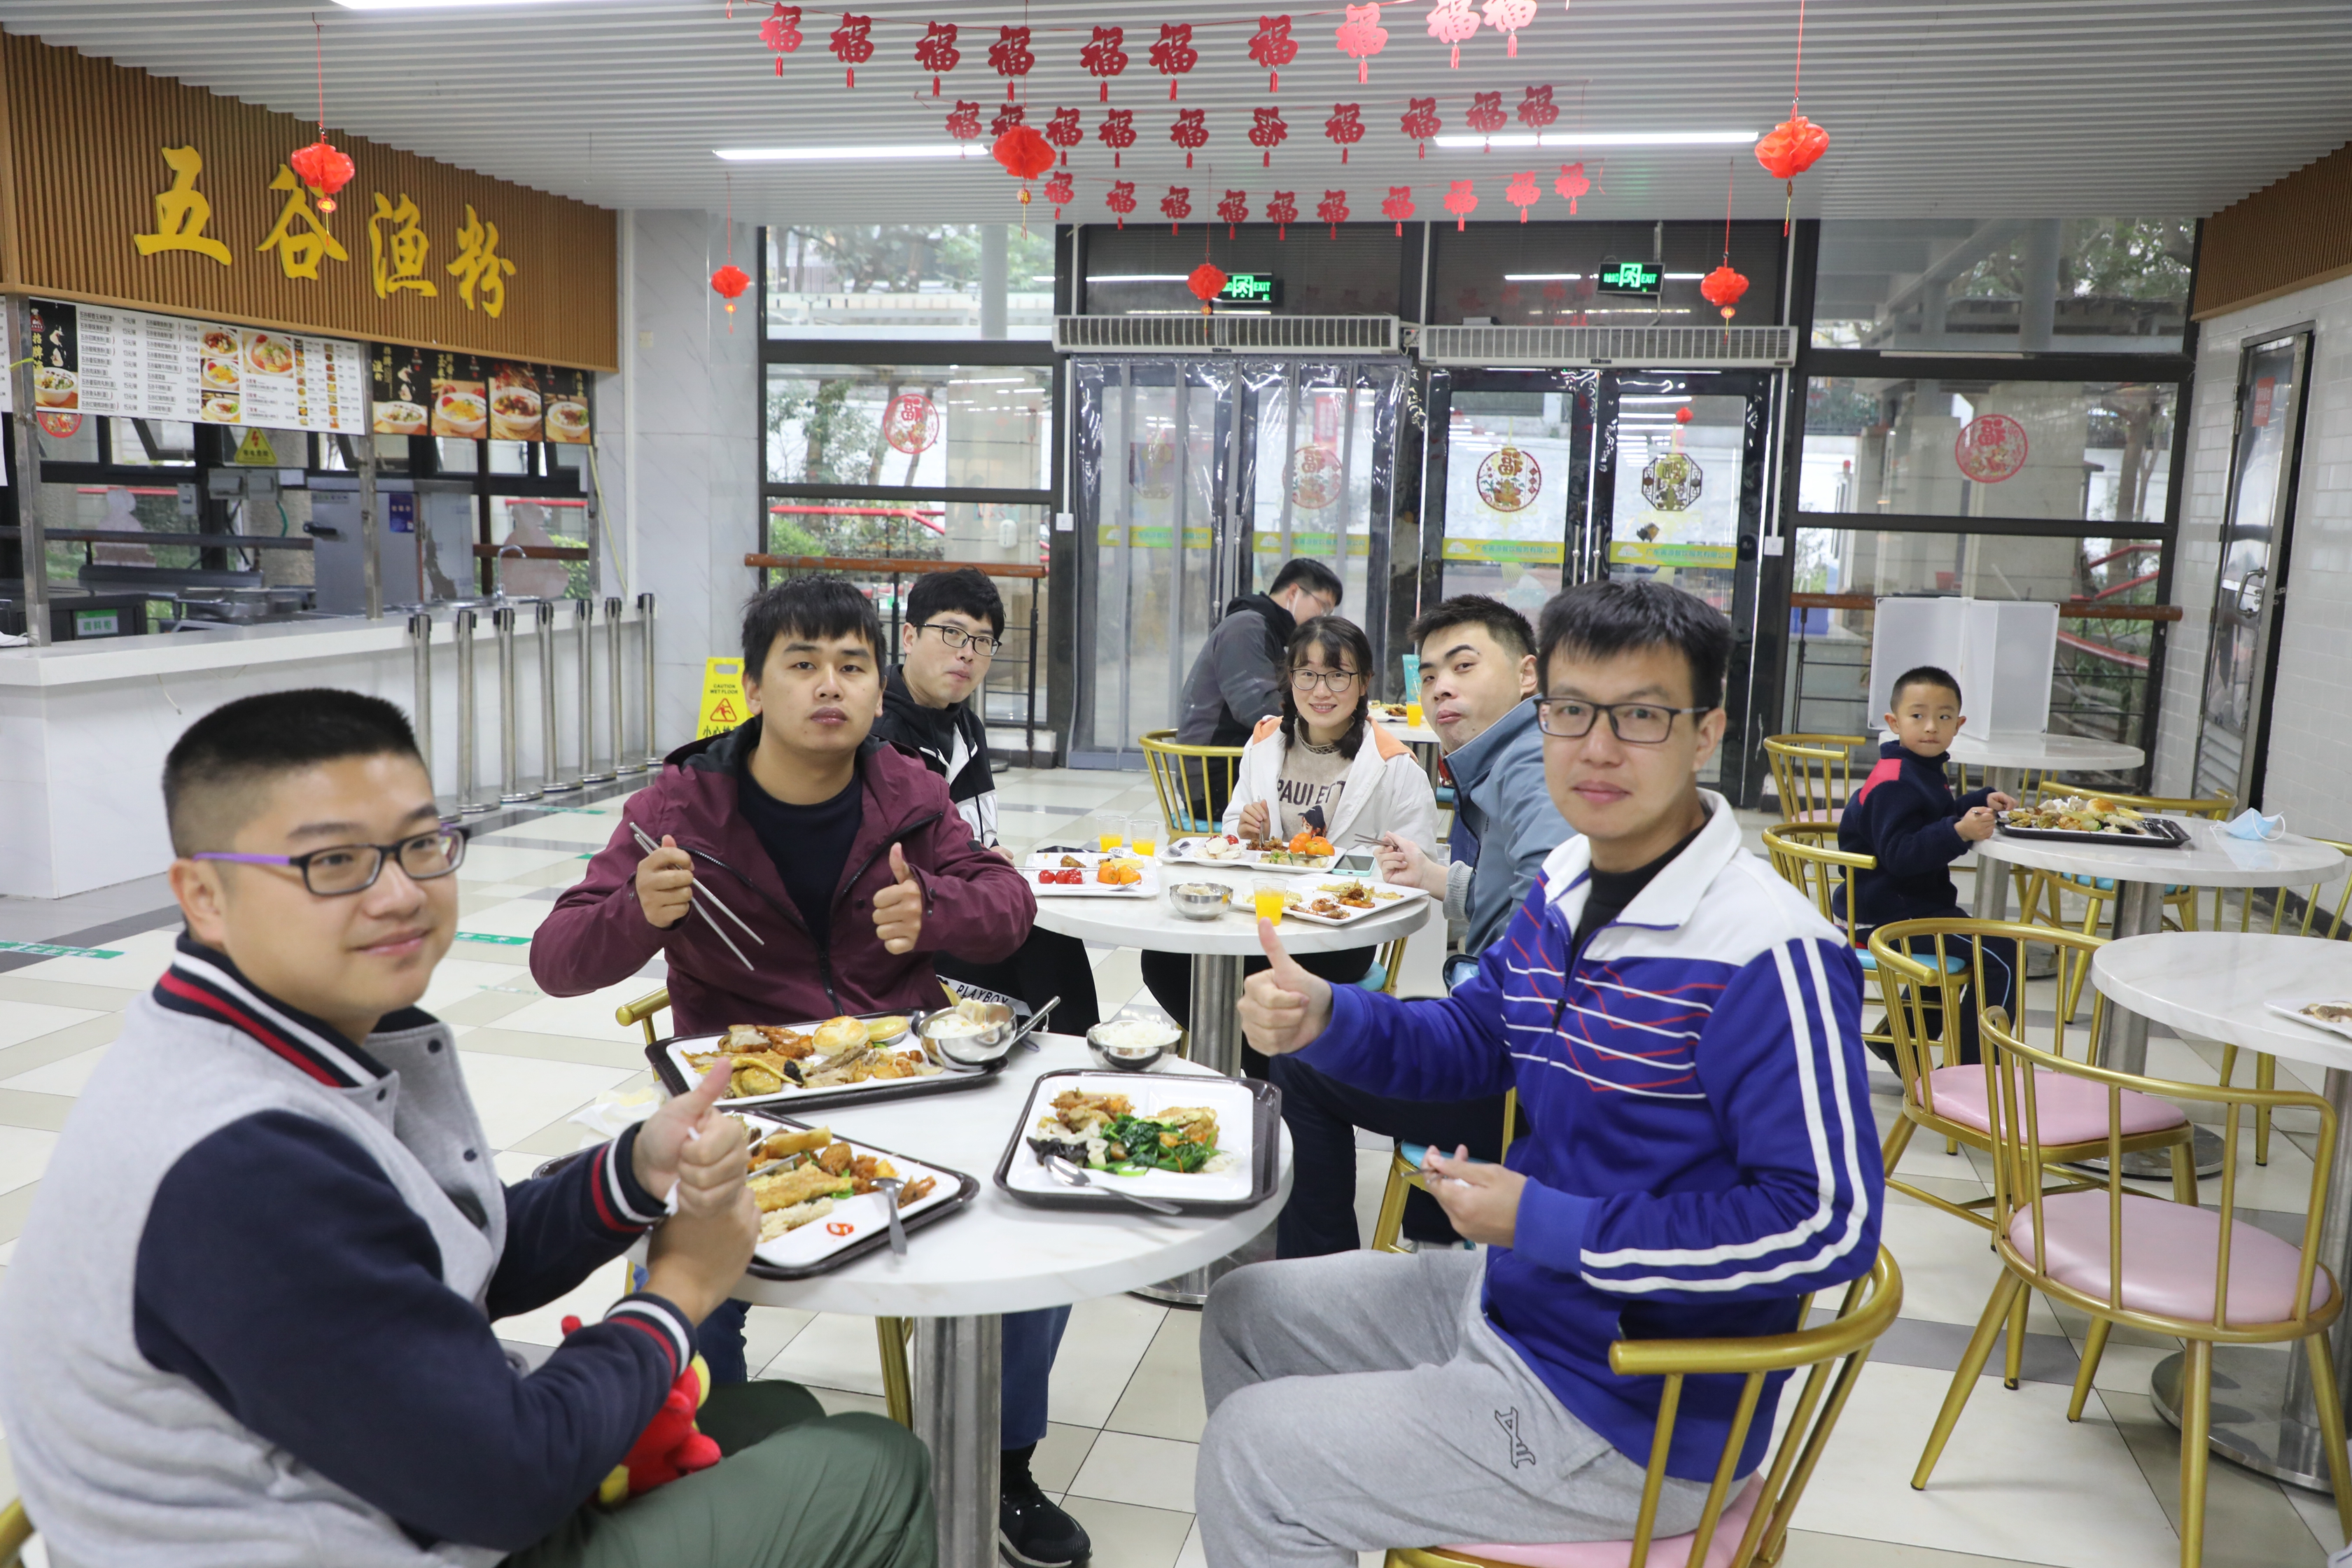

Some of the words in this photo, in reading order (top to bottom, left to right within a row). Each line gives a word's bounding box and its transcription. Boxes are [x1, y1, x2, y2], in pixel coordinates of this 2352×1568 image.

[759, 3, 803, 52] 福
[829, 12, 874, 63] 福
[1248, 15, 1298, 67] 福
[1336, 2, 1388, 58] 福
[1426, 0, 1480, 43] 福
[914, 21, 960, 72] 福
[988, 26, 1035, 76] 福
[1080, 26, 1128, 76] 福
[1149, 23, 1198, 74] 福
[945, 100, 982, 139] 福
[1325, 103, 1365, 144] 福
[1401, 97, 1441, 139] 福
[1466, 91, 1507, 133] 福
[1517, 85, 1560, 127] 福
[1046, 106, 1083, 147] 福
[1098, 108, 1136, 148] 福
[1170, 108, 1209, 148] 福
[1044, 171, 1074, 204] 福
[1105, 180, 1136, 214] 福
[1443, 179, 1478, 214] 福
[1505, 171, 1541, 206] 福
[1554, 162, 1590, 199] 福
[1161, 186, 1191, 219] 福
[1217, 189, 1249, 223] 福
[1266, 190, 1298, 223] 福
[1317, 190, 1350, 223] 福
[1382, 186, 1415, 220] 福
[133, 145, 517, 318] 五谷渔粉
[1253, 281, 1271, 292] EXIT
[1641, 274, 1657, 284] EXIT
[703, 726, 736, 738] 小心地
